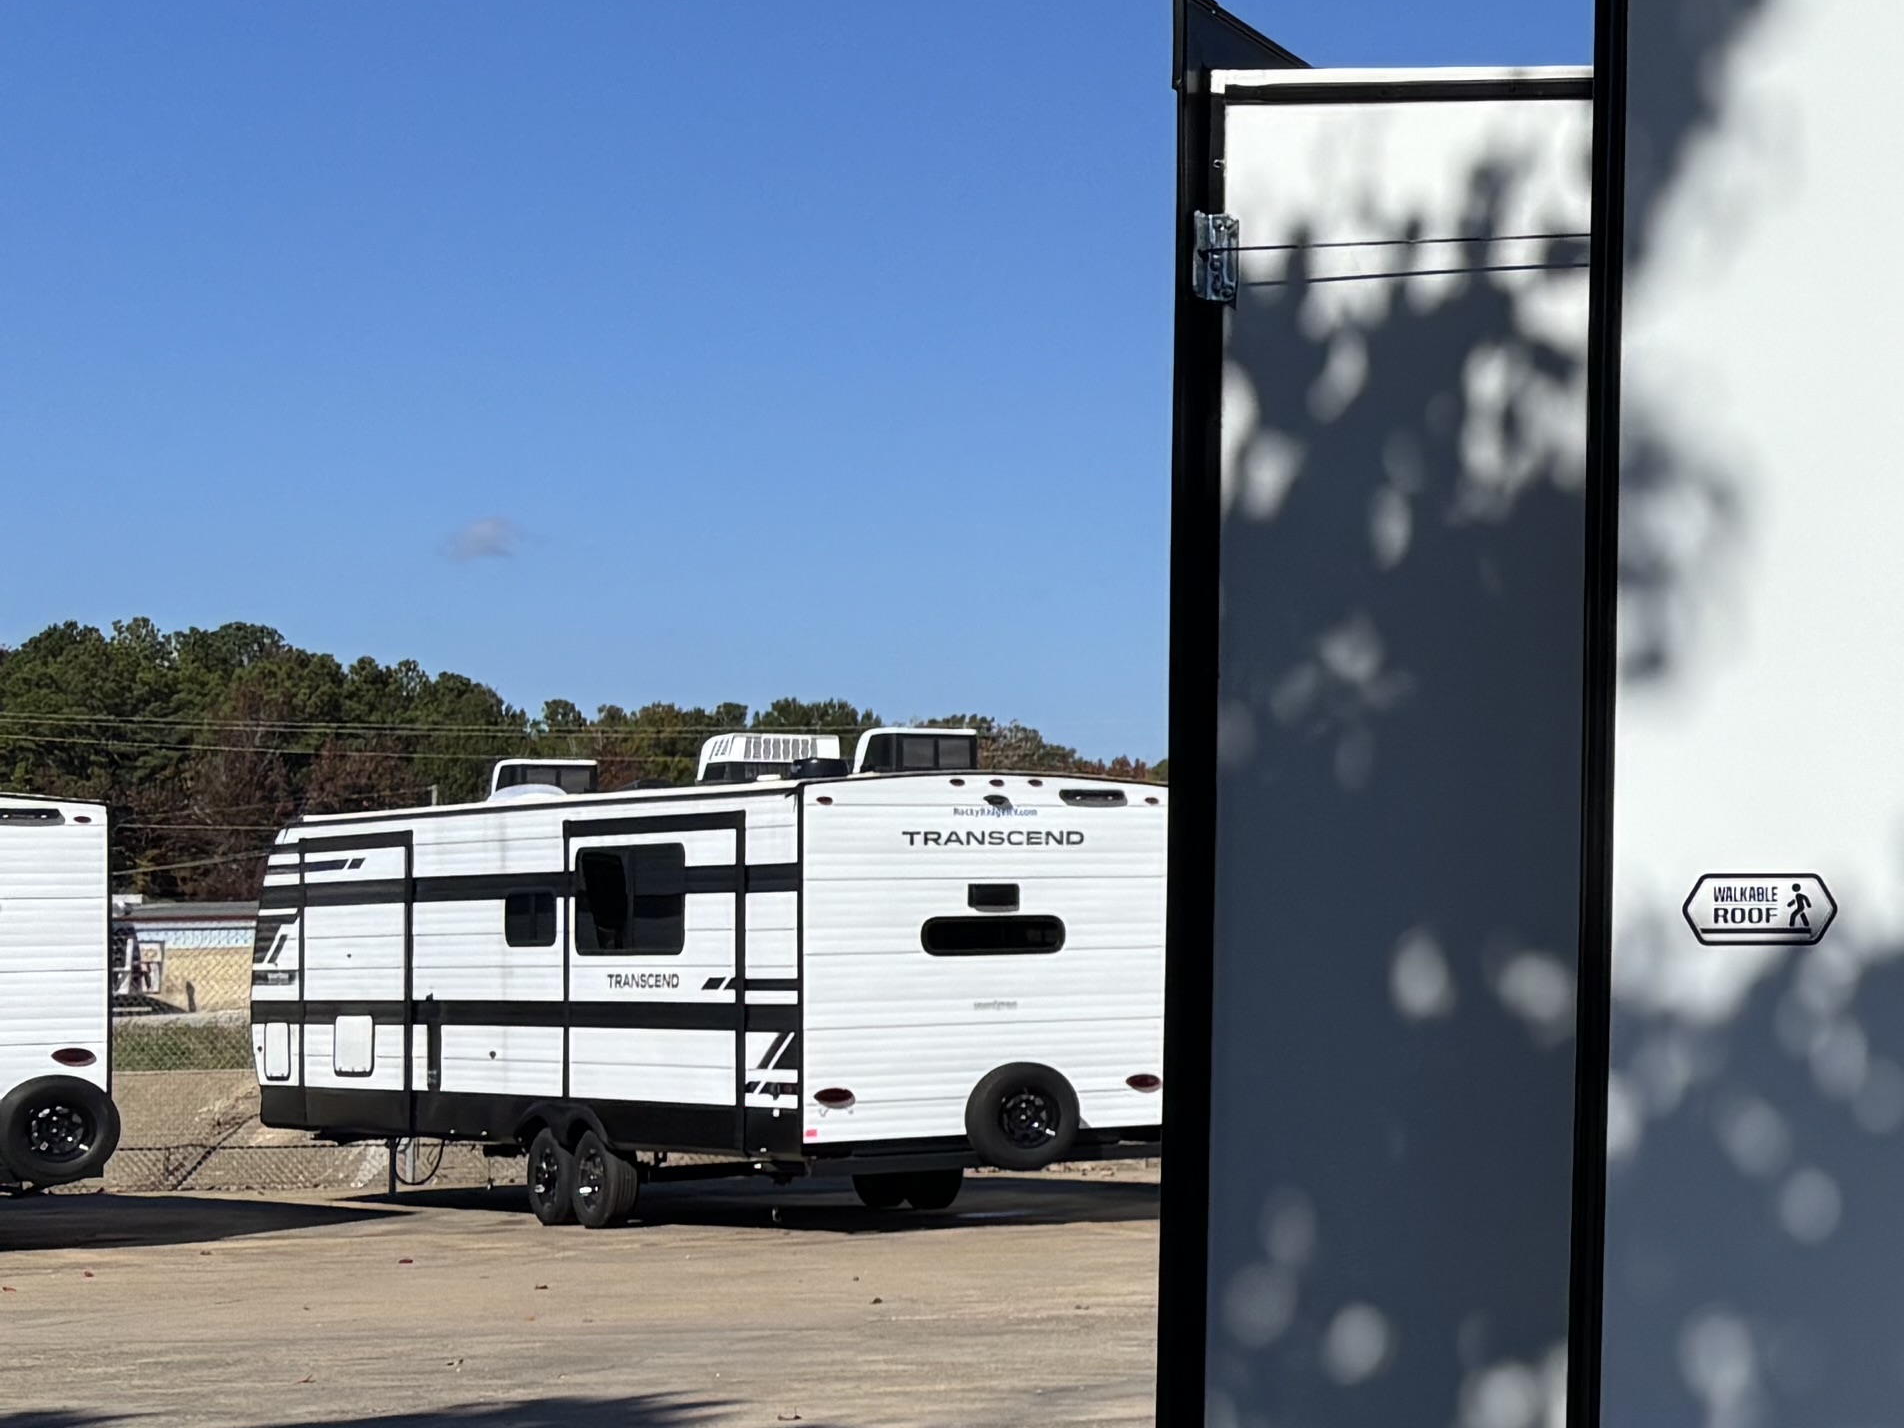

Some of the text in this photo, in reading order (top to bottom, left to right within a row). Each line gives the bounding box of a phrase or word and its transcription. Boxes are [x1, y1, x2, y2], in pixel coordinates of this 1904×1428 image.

[902, 830, 1085, 846] TRANSCEND
[1713, 886, 1778, 903] WALKABLE
[1713, 907, 1778, 924] ROOF
[607, 973, 680, 989] TRANSCEND
